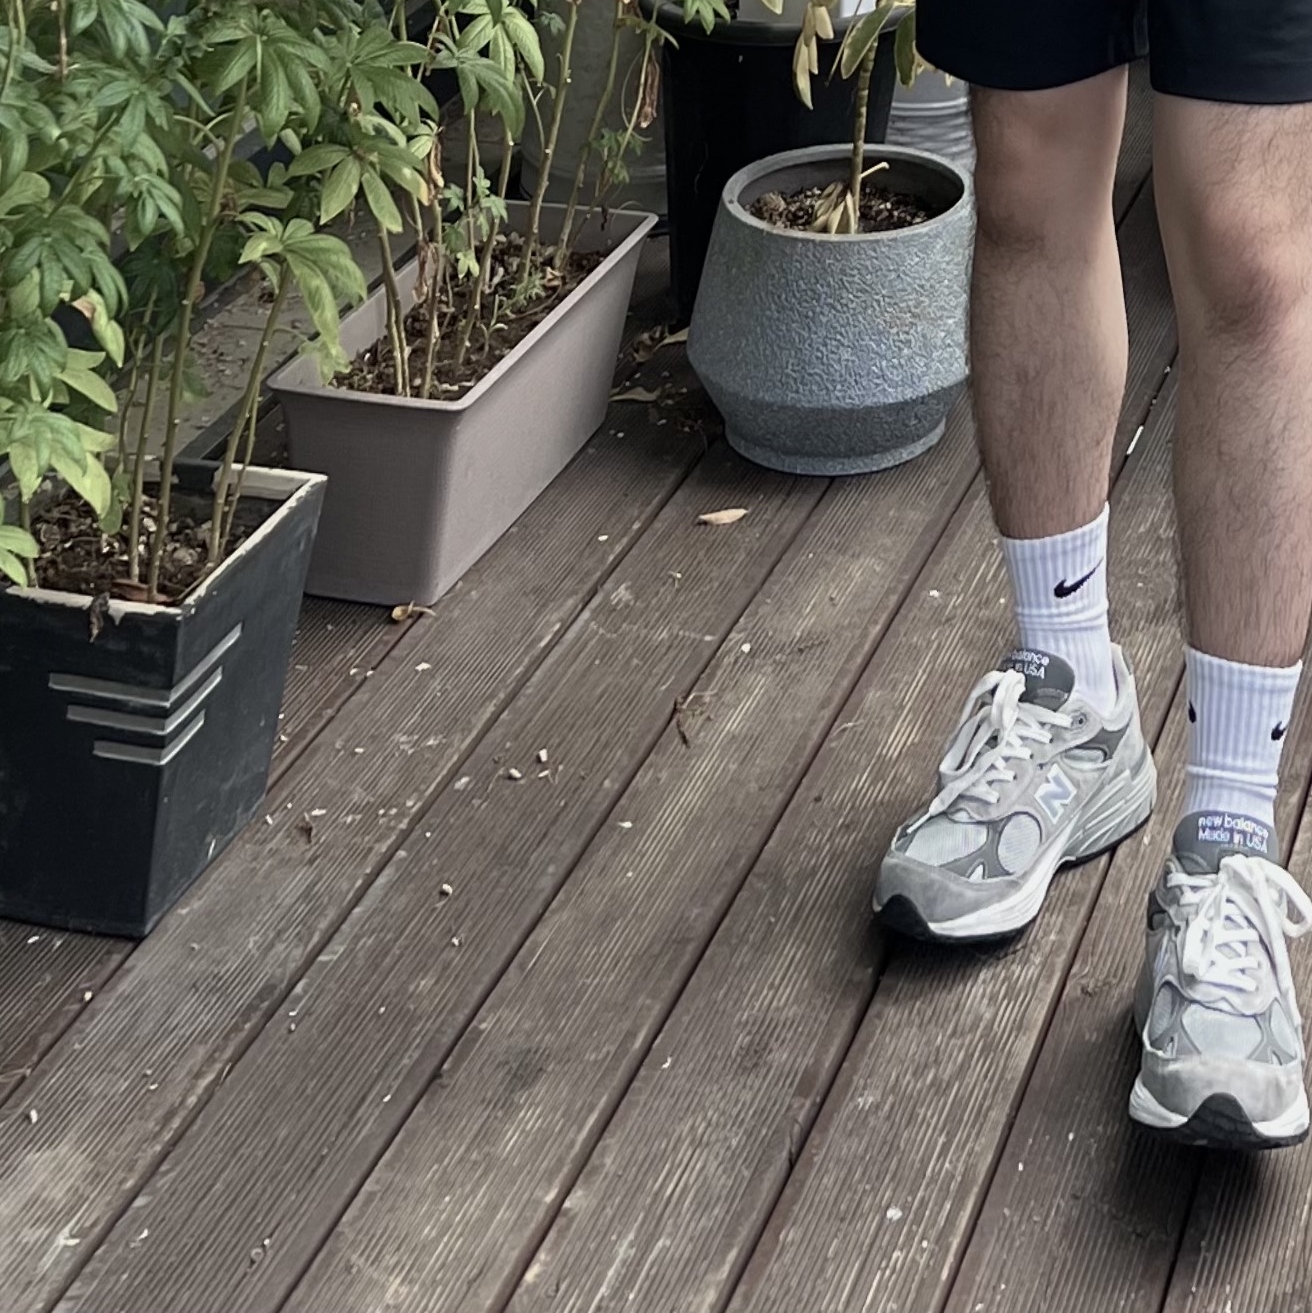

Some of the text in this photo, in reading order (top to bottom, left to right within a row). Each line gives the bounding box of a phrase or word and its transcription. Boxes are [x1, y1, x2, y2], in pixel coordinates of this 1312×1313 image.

[1024, 662, 1045, 679] USA
[1034, 763, 1077, 824] N
[1198, 813, 1269, 838] new balance
[1198, 827, 1230, 841] Made
[1246, 833, 1268, 854] USA
